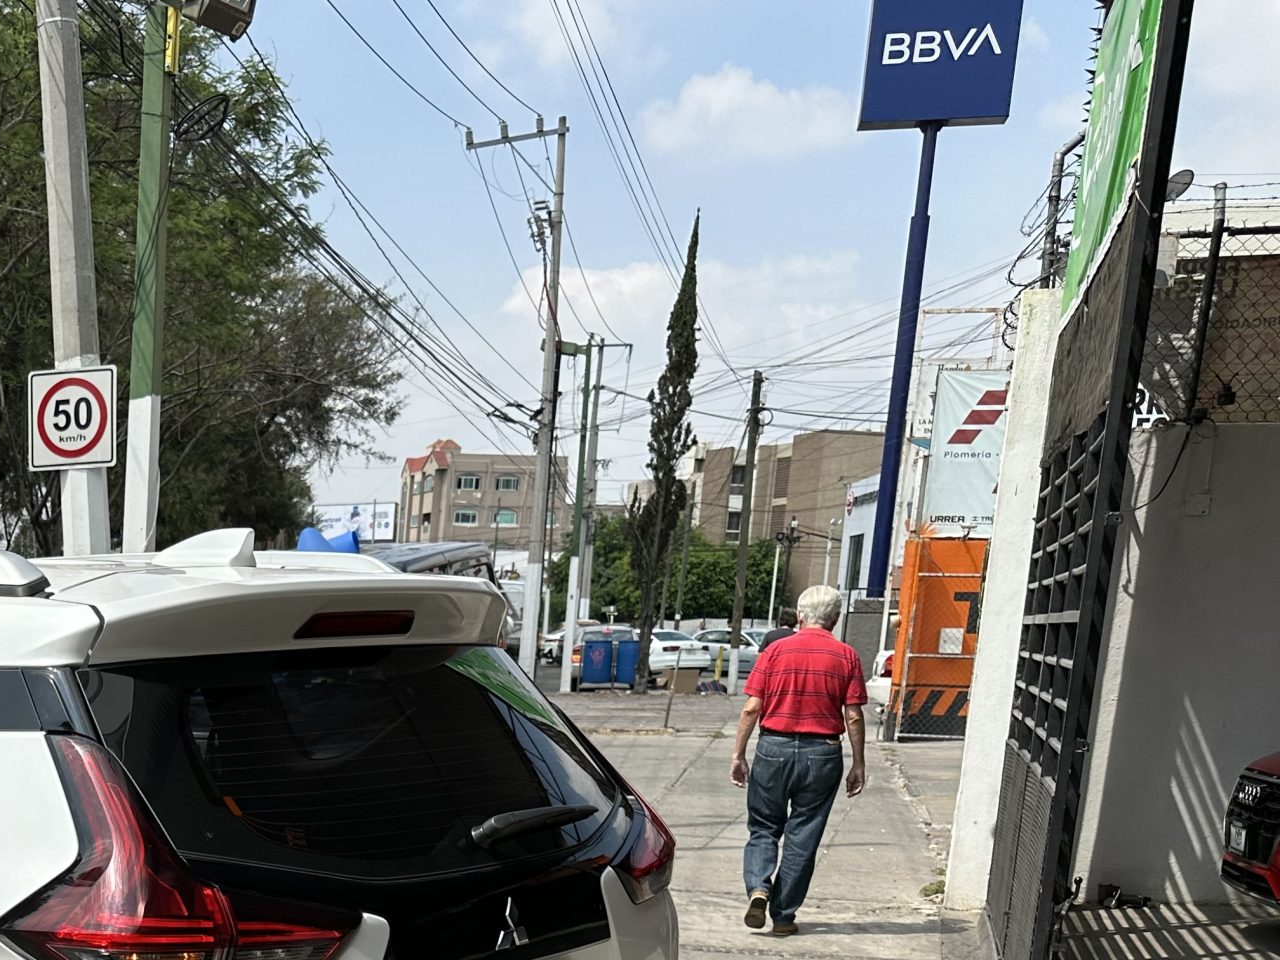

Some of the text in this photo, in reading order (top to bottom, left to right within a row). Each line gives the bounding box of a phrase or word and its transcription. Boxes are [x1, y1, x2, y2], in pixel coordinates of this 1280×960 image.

[881, 22, 1002, 65] BBVA
[53, 397, 92, 432] 50
[59, 433, 86, 443] km/h
[930, 515, 966, 523] URREA
